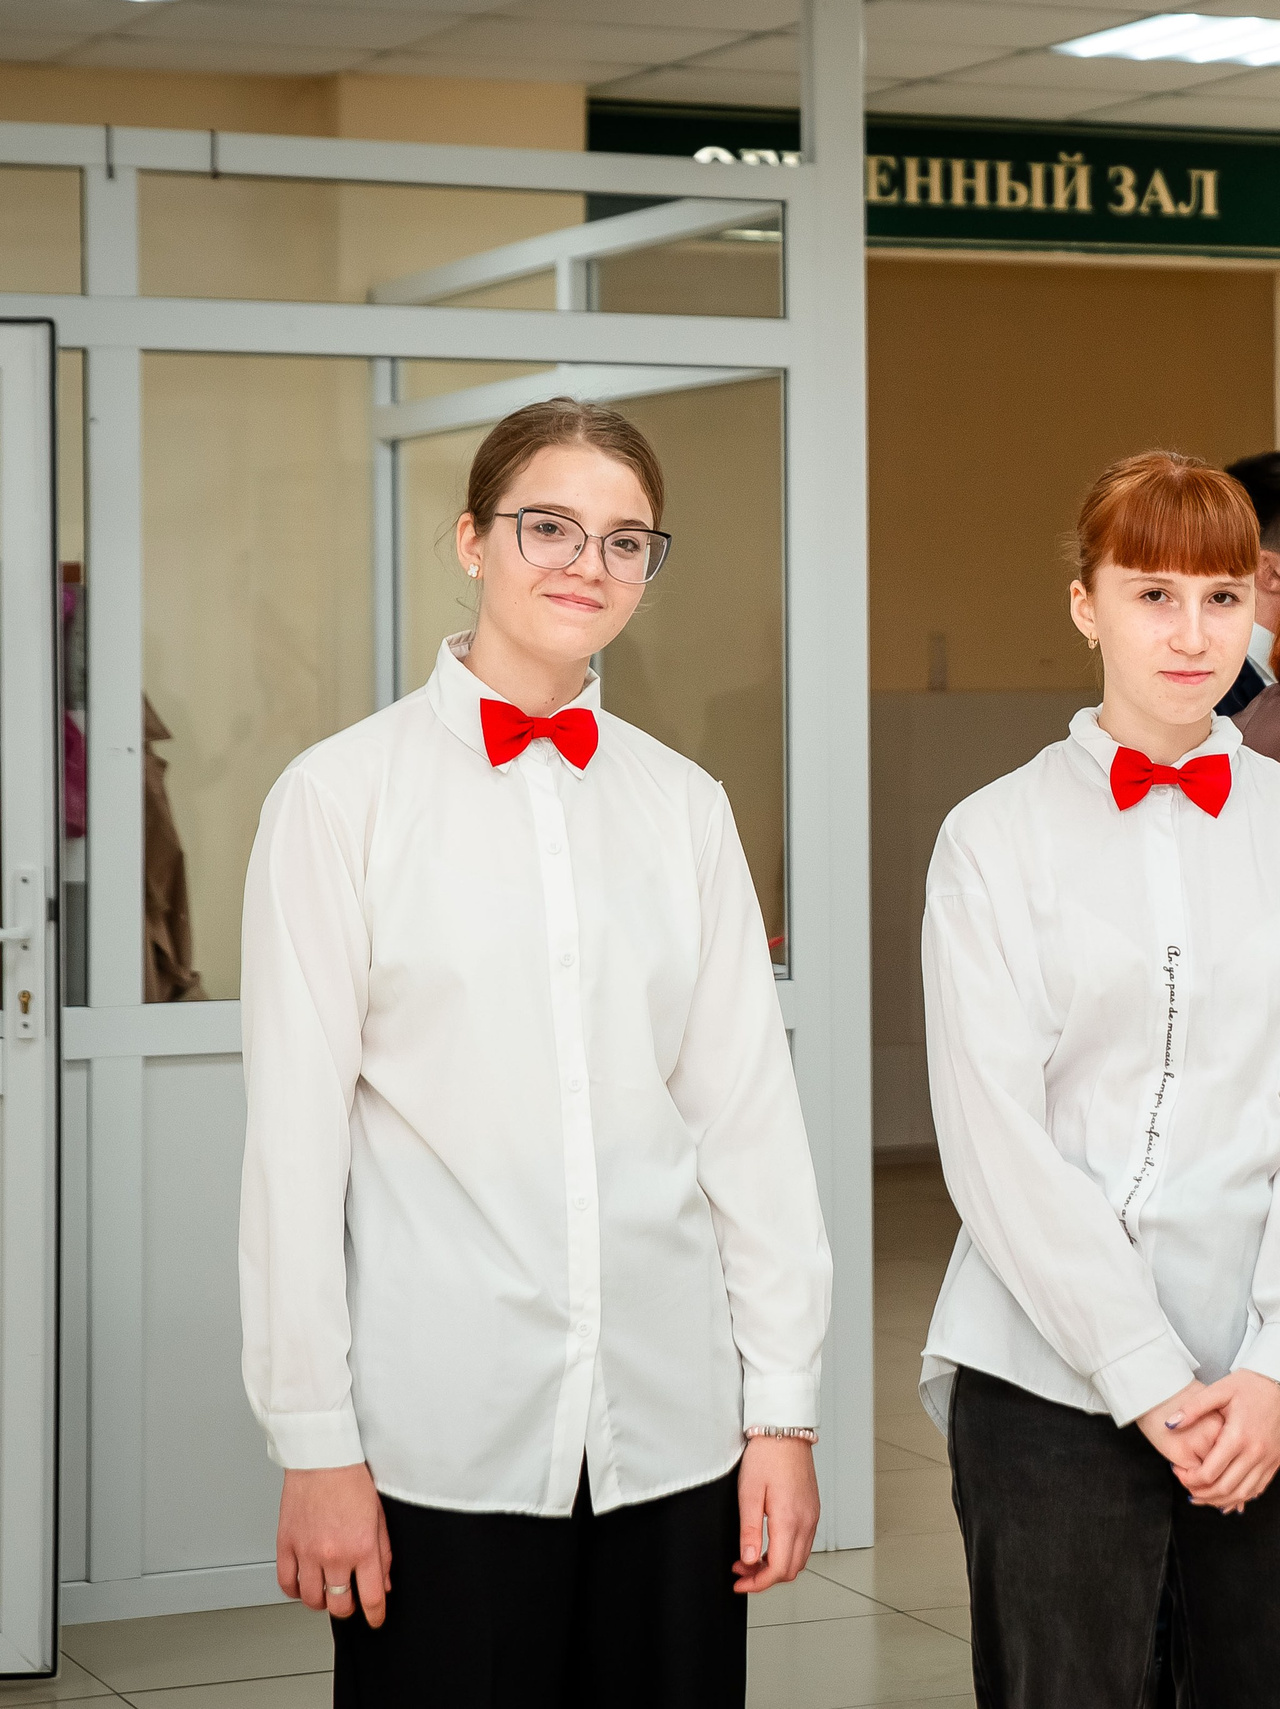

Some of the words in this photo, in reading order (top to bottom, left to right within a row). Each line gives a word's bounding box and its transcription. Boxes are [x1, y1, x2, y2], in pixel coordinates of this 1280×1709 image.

[1108, 165, 1219, 217] ЗАЛ
[1165, 983, 1176, 1006] pas
[1168, 1006, 1178, 1021] de
